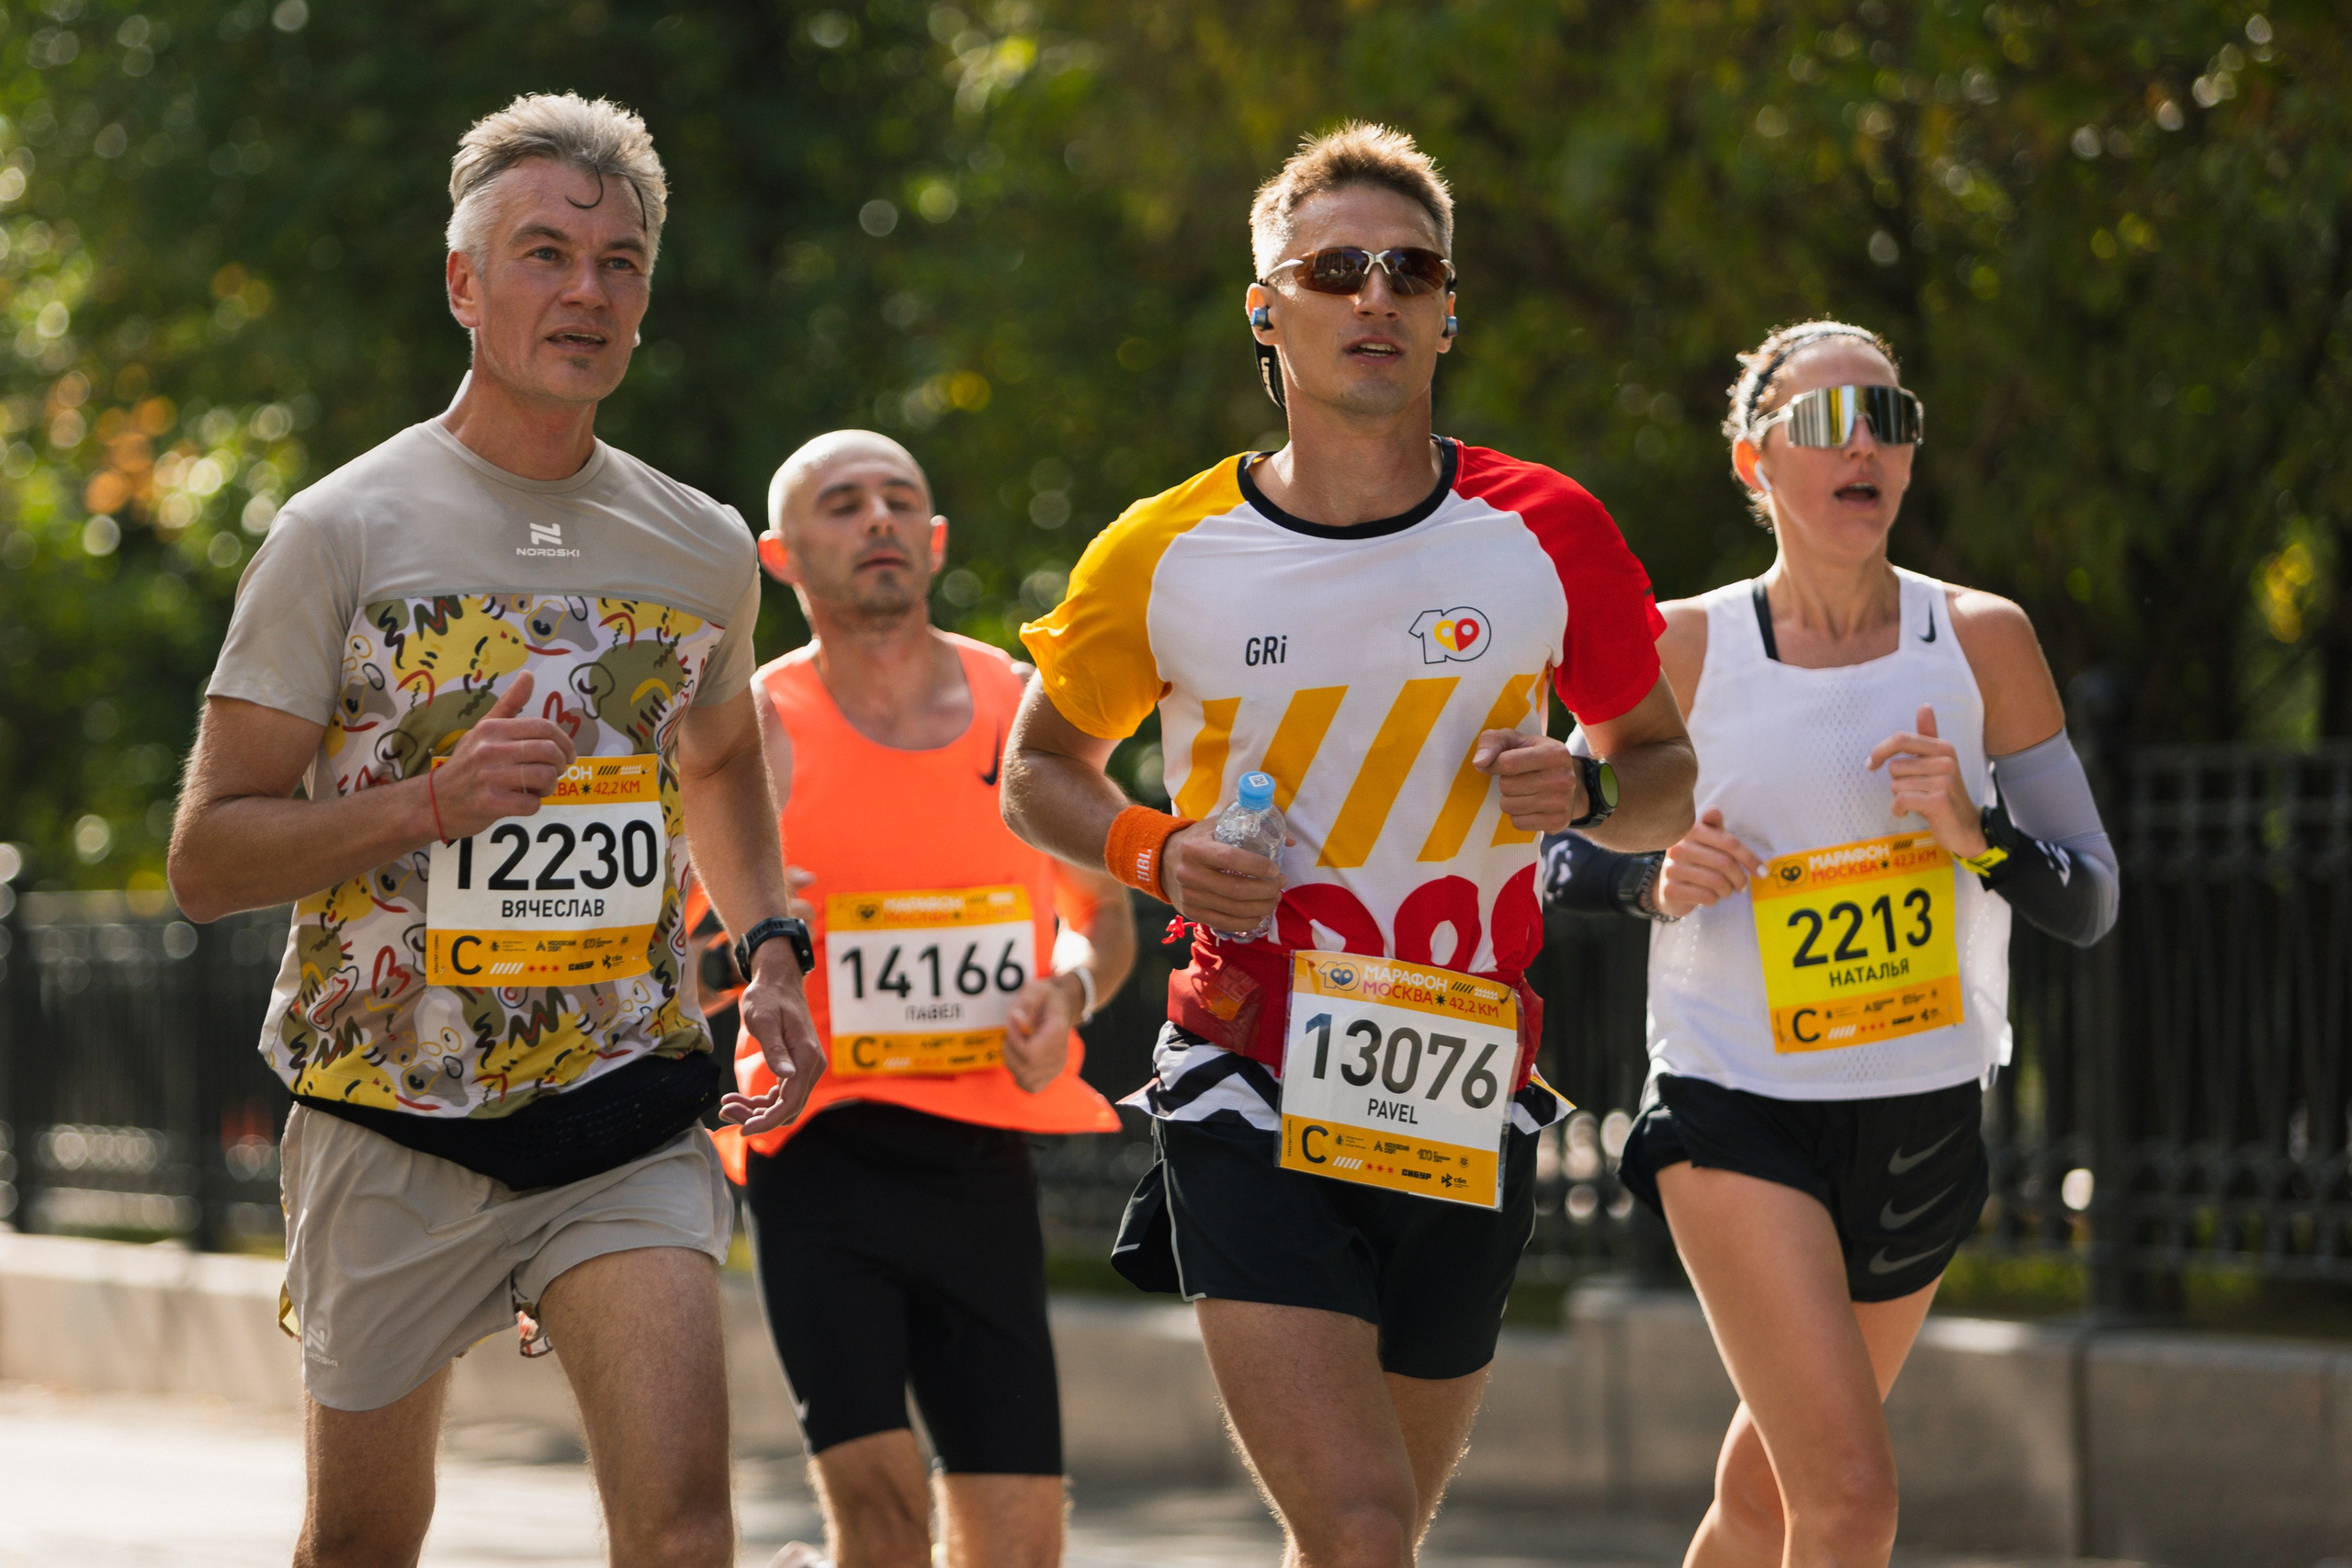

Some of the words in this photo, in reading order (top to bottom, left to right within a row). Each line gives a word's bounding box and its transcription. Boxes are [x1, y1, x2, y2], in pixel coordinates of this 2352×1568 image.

[516, 547, 580, 558] NORDSKI
[1245, 635, 1287, 666] GRi
[594, 781, 618, 796] 42,2
[446, 819, 658, 890] 12230
[1808, 843, 1890, 871] МАРАФОН
[1812, 860, 1879, 883] МОСКВА
[502, 898, 605, 918] ВЯЧЕСЛАВ
[1787, 887, 1932, 968] 2213
[840, 938, 1024, 999] 14166
[1363, 964, 1448, 992] МАРАФОН
[1829, 958, 1910, 987] НАТАЛЬЯ
[1363, 980, 1433, 1006] МОСКВА
[1449, 997, 1476, 1014] 42,2
[1305, 1012, 1499, 1109] 13076
[1367, 1098, 1419, 1125] PAVEL
[1401, 1168, 1431, 1180] СИБУР
